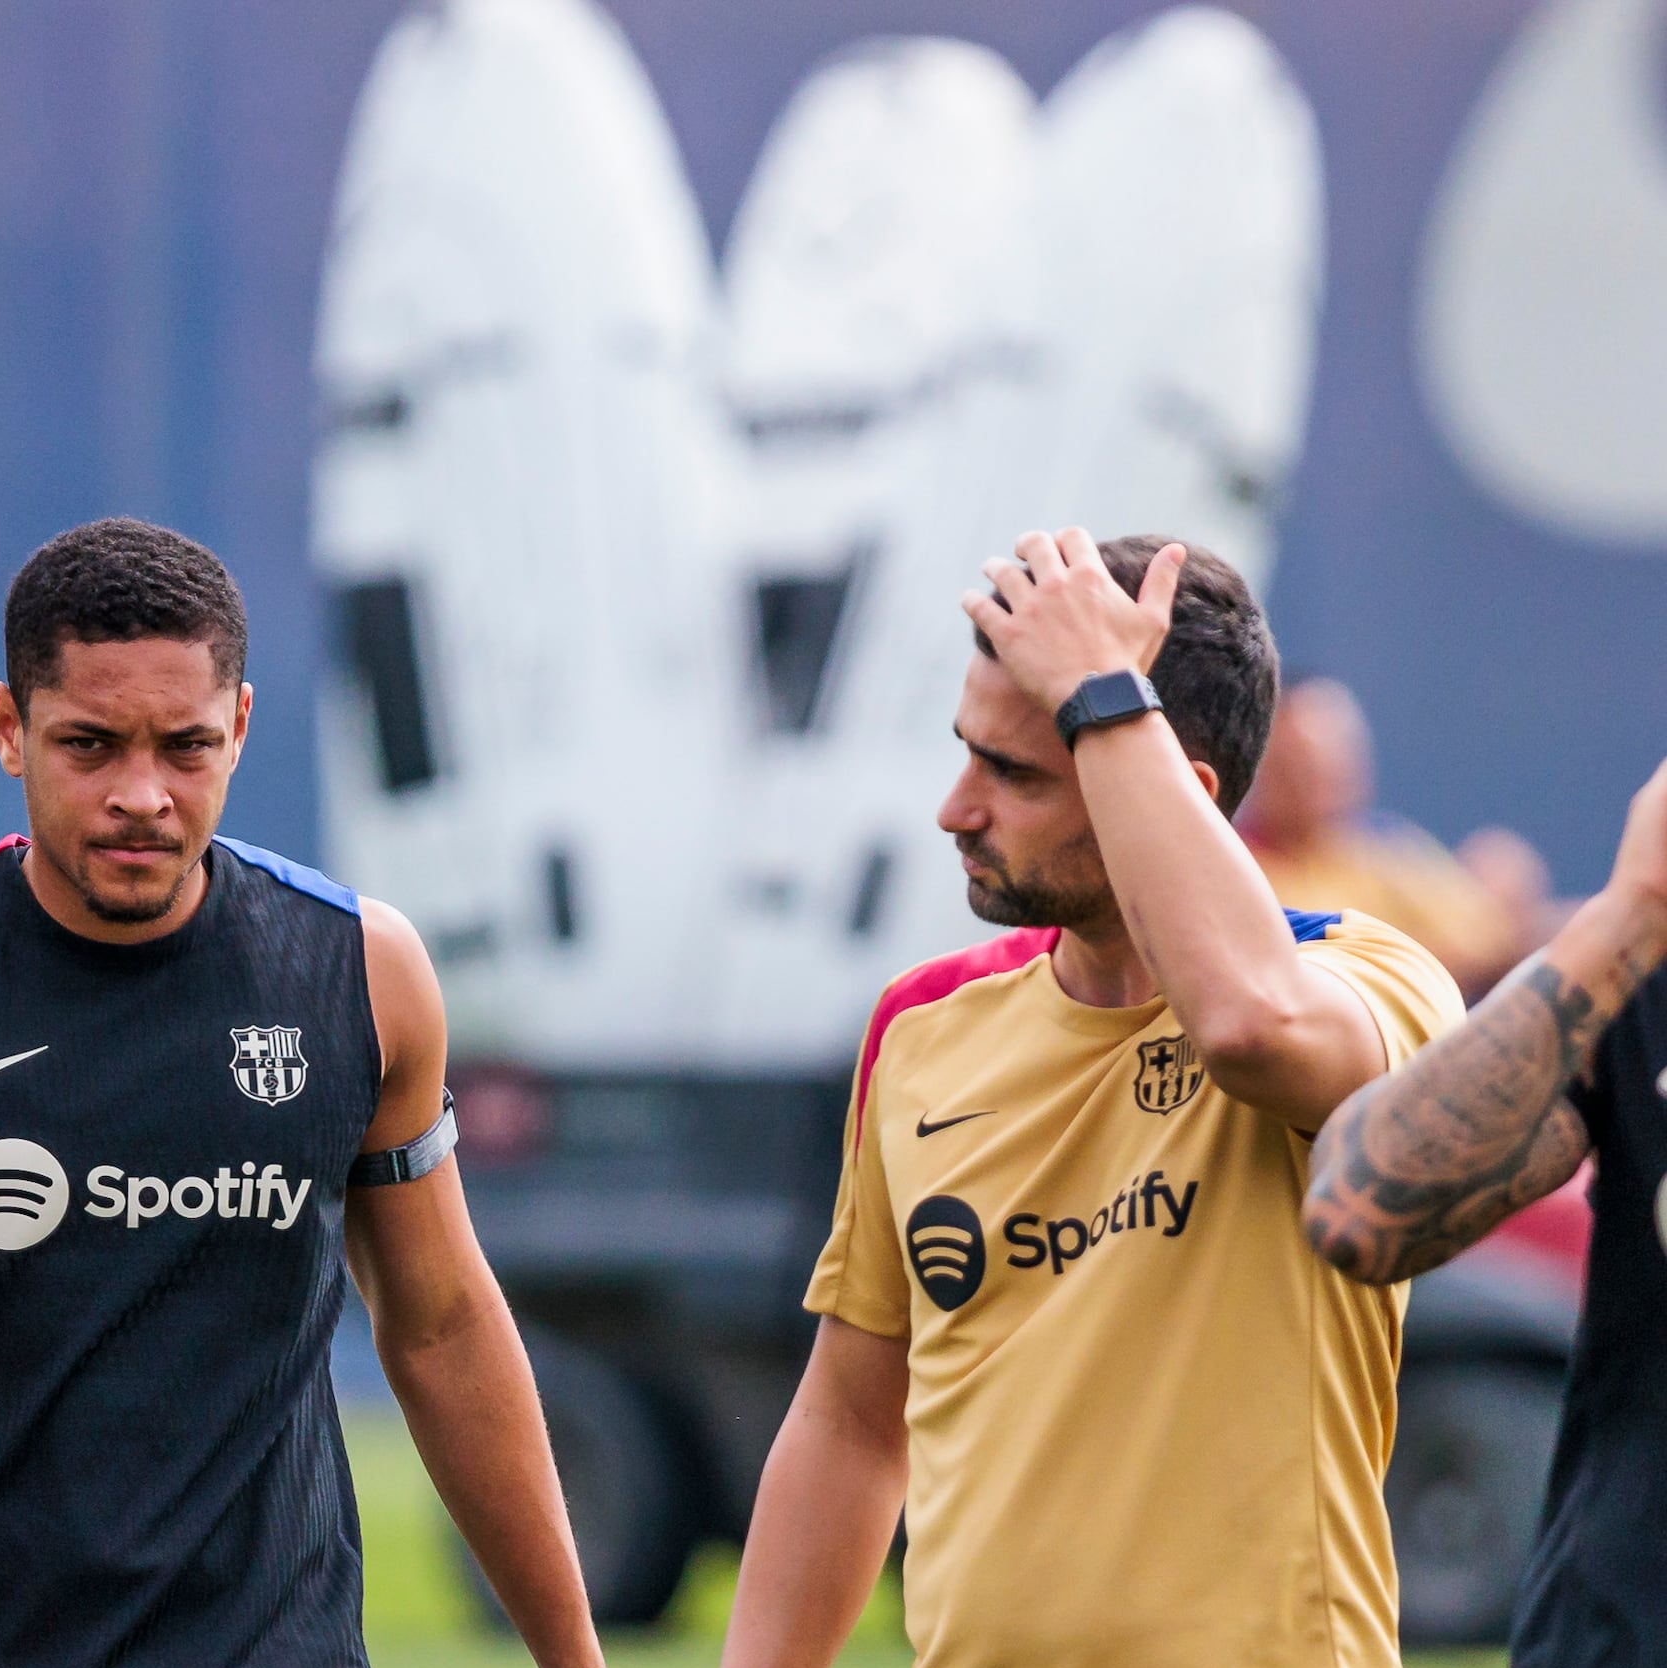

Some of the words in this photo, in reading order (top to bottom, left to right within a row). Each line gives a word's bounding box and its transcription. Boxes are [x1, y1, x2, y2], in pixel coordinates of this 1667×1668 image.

[255, 1058, 284, 1068] FCB
[83, 1161, 313, 1230] Spotify
[1003, 1170, 1199, 1275] Spotify
